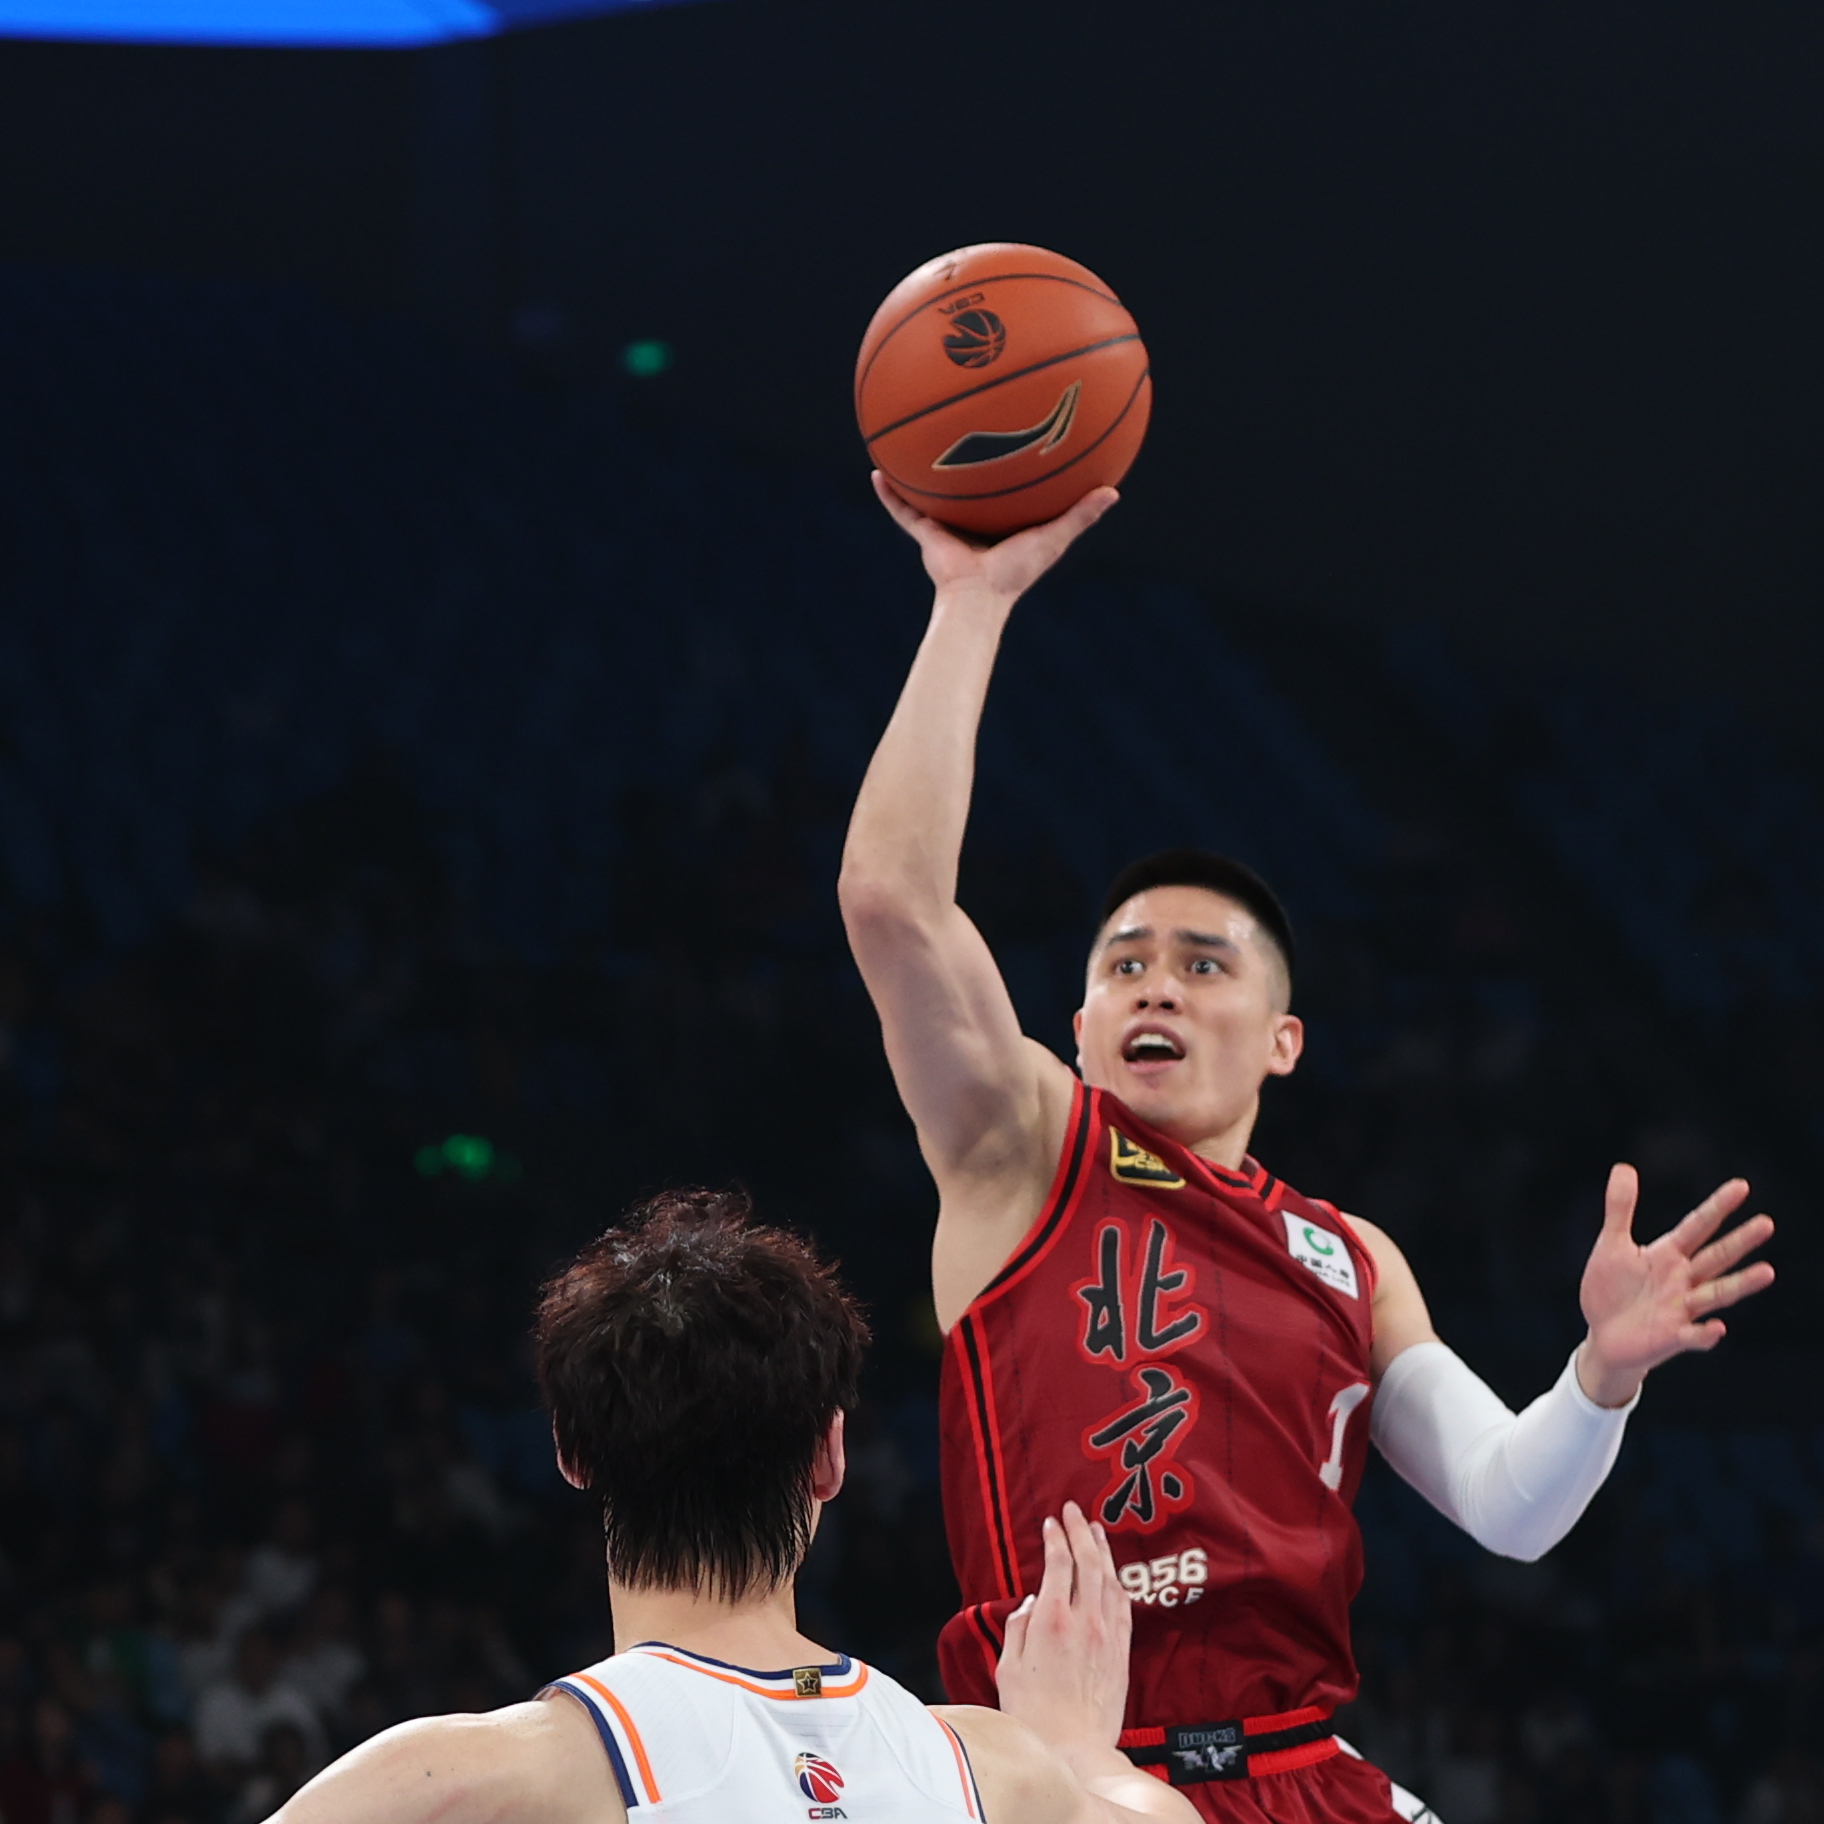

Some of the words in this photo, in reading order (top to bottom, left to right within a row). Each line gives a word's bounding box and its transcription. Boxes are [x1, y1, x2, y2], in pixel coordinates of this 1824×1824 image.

[1078, 1219, 1200, 1523] 北京
[1118, 1547, 1208, 1596] 956
[807, 1806, 849, 1820] CBA
